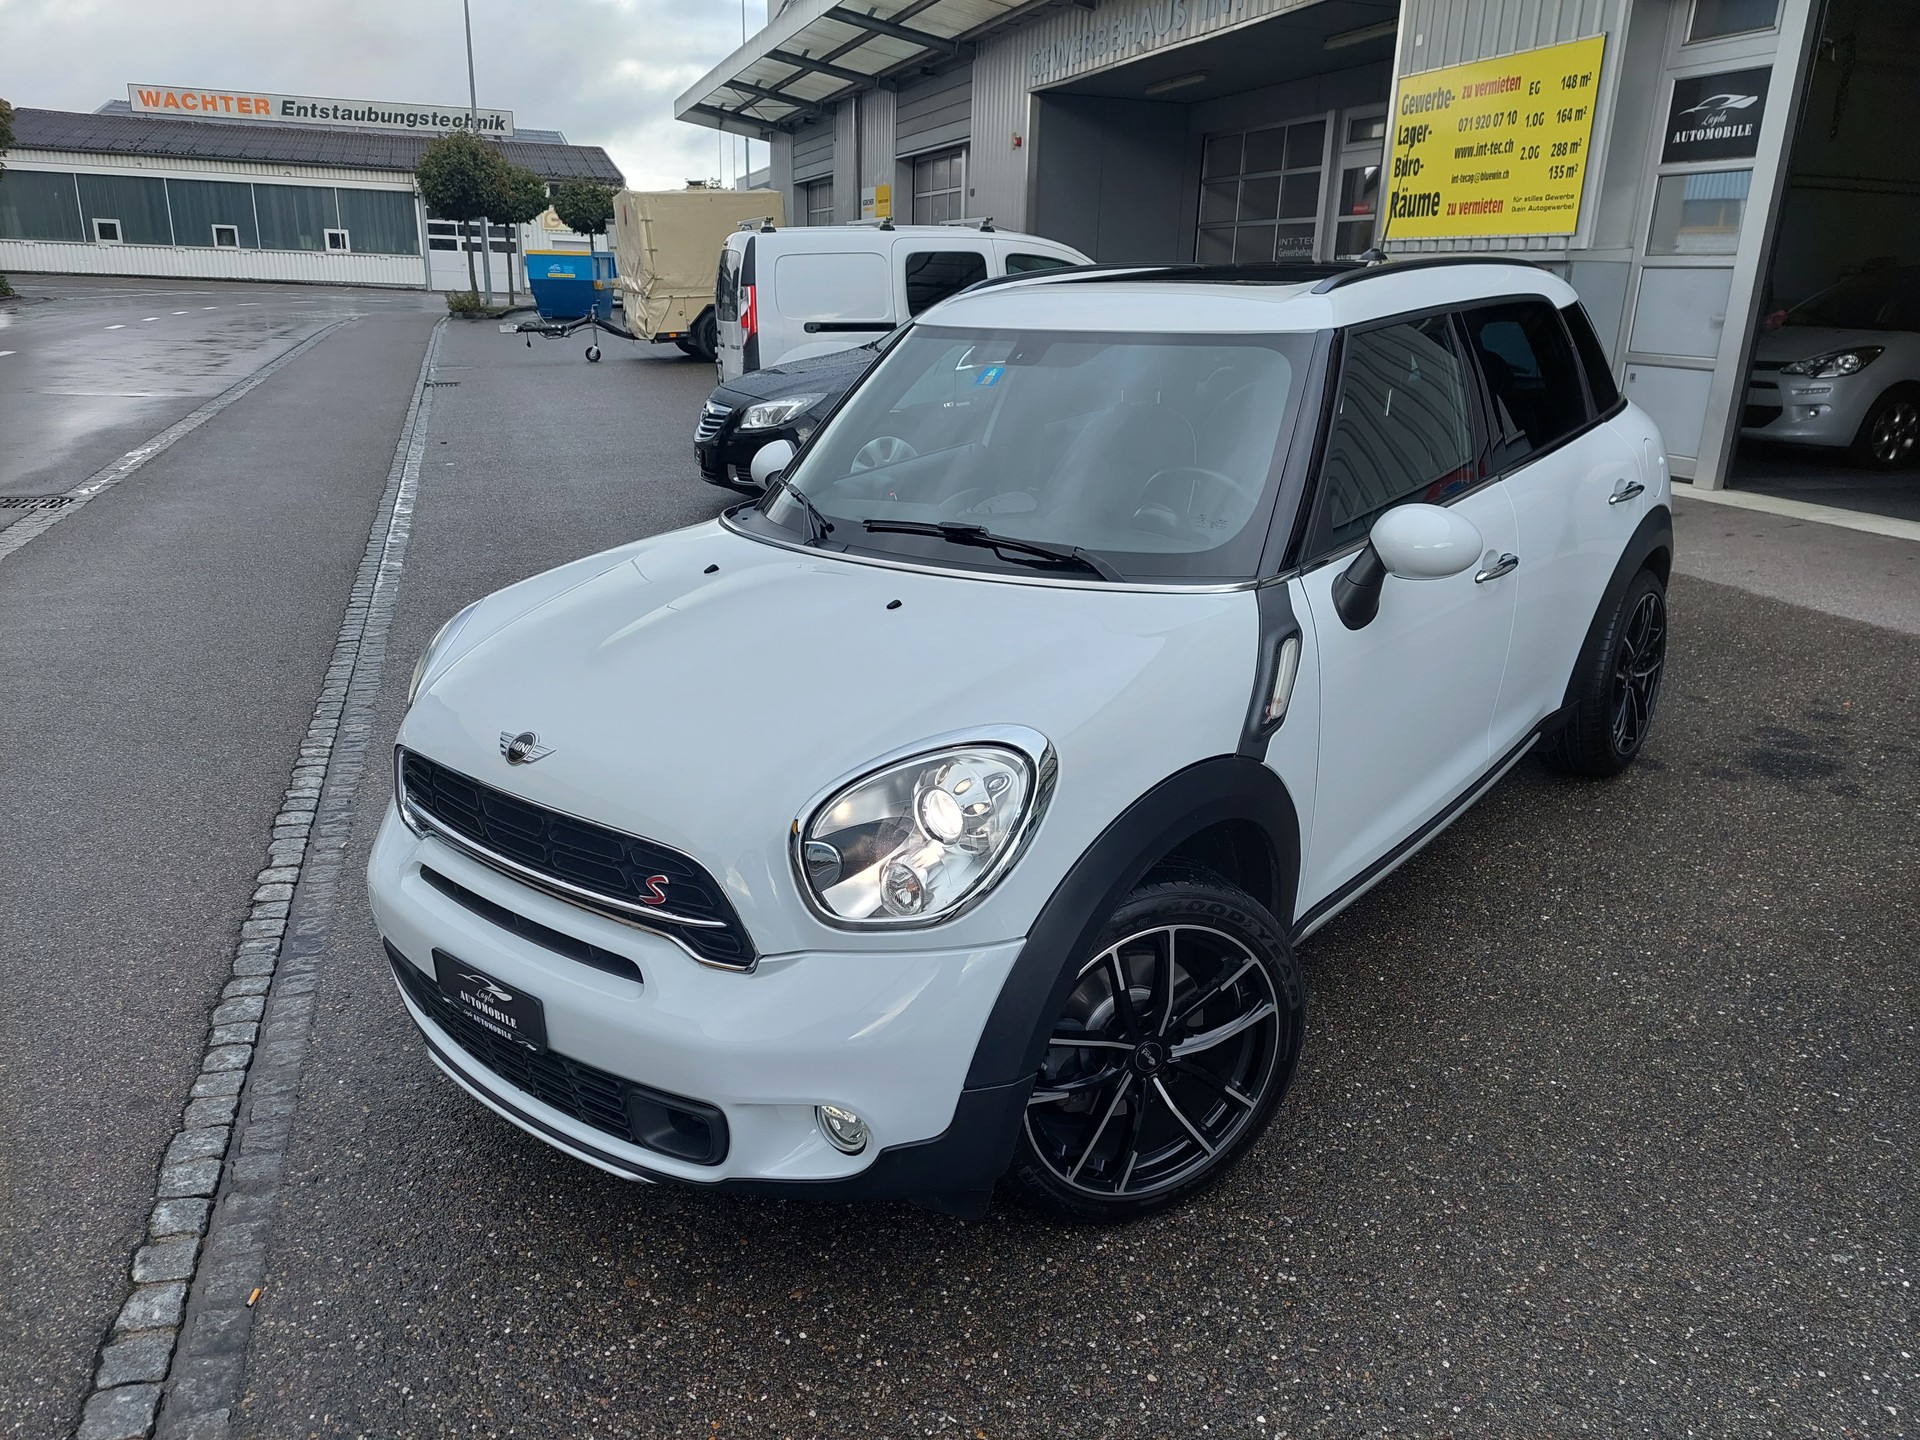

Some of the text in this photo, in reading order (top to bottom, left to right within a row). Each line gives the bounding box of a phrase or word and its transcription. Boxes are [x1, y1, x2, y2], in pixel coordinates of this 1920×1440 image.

[1031, 0, 1187, 77] GEWERBEHAUS
[1461, 75, 1521, 99] zu vermieten
[1529, 80, 1541, 96] EG
[1561, 74, 1578, 90] 148
[137, 89, 506, 131] WACHTER Entstaubungstechnik
[1402, 87, 1455, 116] Gewerbe-
[1458, 109, 1518, 132] 071 920 07 10
[1557, 108, 1573, 124] 164
[1397, 123, 1432, 149] Lager-
[1672, 123, 1753, 143] AUTOMOBILE
[1454, 138, 1514, 159] www.int-tec.ch
[1551, 142, 1568, 157] 288
[1394, 154, 1424, 178] Büro-
[1451, 169, 1510, 184] int-tecag@bluewin.ch
[1549, 164, 1565, 180] 135
[1391, 187, 1440, 218] Räume
[1446, 198, 1504, 216] zu vermieten
[1545, 193, 1575, 201] Gewerbe
[512, 740, 531, 754] MINI
[639, 875, 669, 905] S
[460, 990, 518, 1029] AUTOMOBILE
[473, 1014, 513, 1041] AUTOMOBILE
